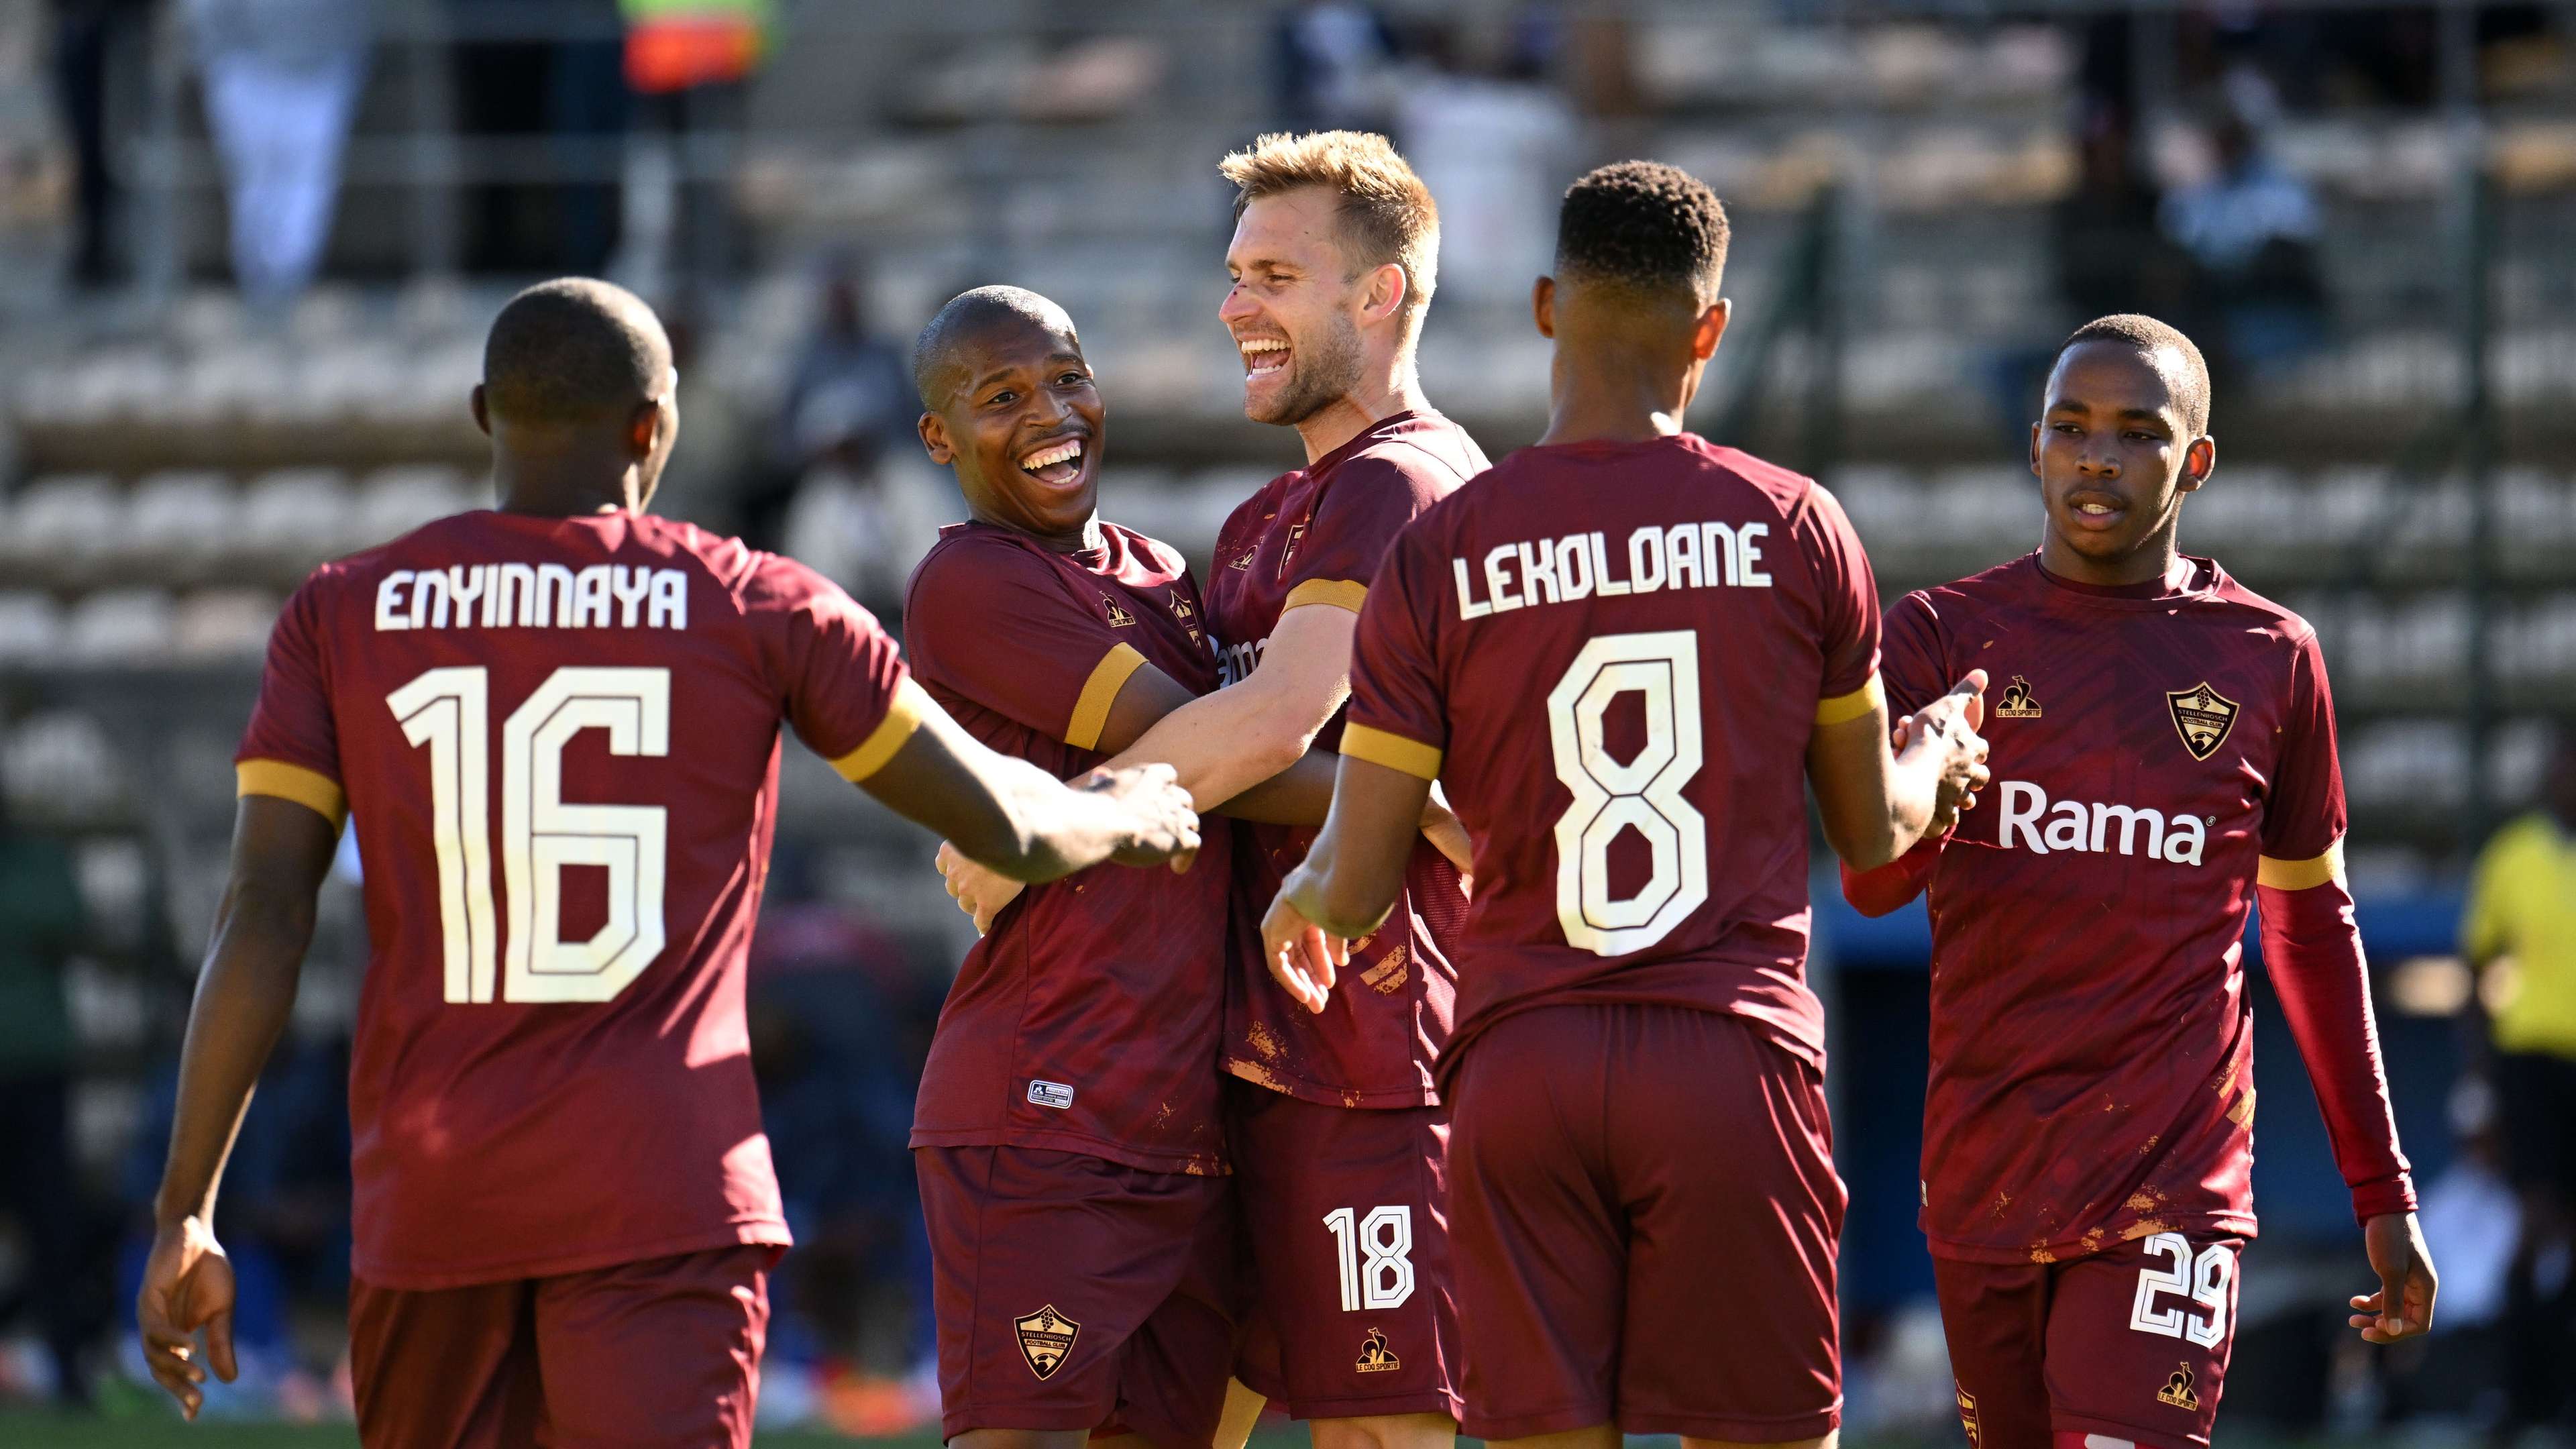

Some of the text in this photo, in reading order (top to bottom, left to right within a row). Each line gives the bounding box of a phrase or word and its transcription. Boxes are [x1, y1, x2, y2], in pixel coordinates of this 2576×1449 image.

[374, 563, 688, 631] ENYINNAYA
[1452, 521, 1772, 621] LEKOLOANE
[2178, 709, 2228, 722] STELLENBOSCH
[2183, 717, 2208, 725] FOOTBALL
[385, 665, 671, 1004] 16
[1547, 629, 1709, 957] 8
[1999, 780, 2206, 867] Rama
[1322, 1205, 1415, 1311] 18
[2129, 1232, 2234, 1350] 29
[1021, 1331, 1071, 1342] STELLENBOSCH
